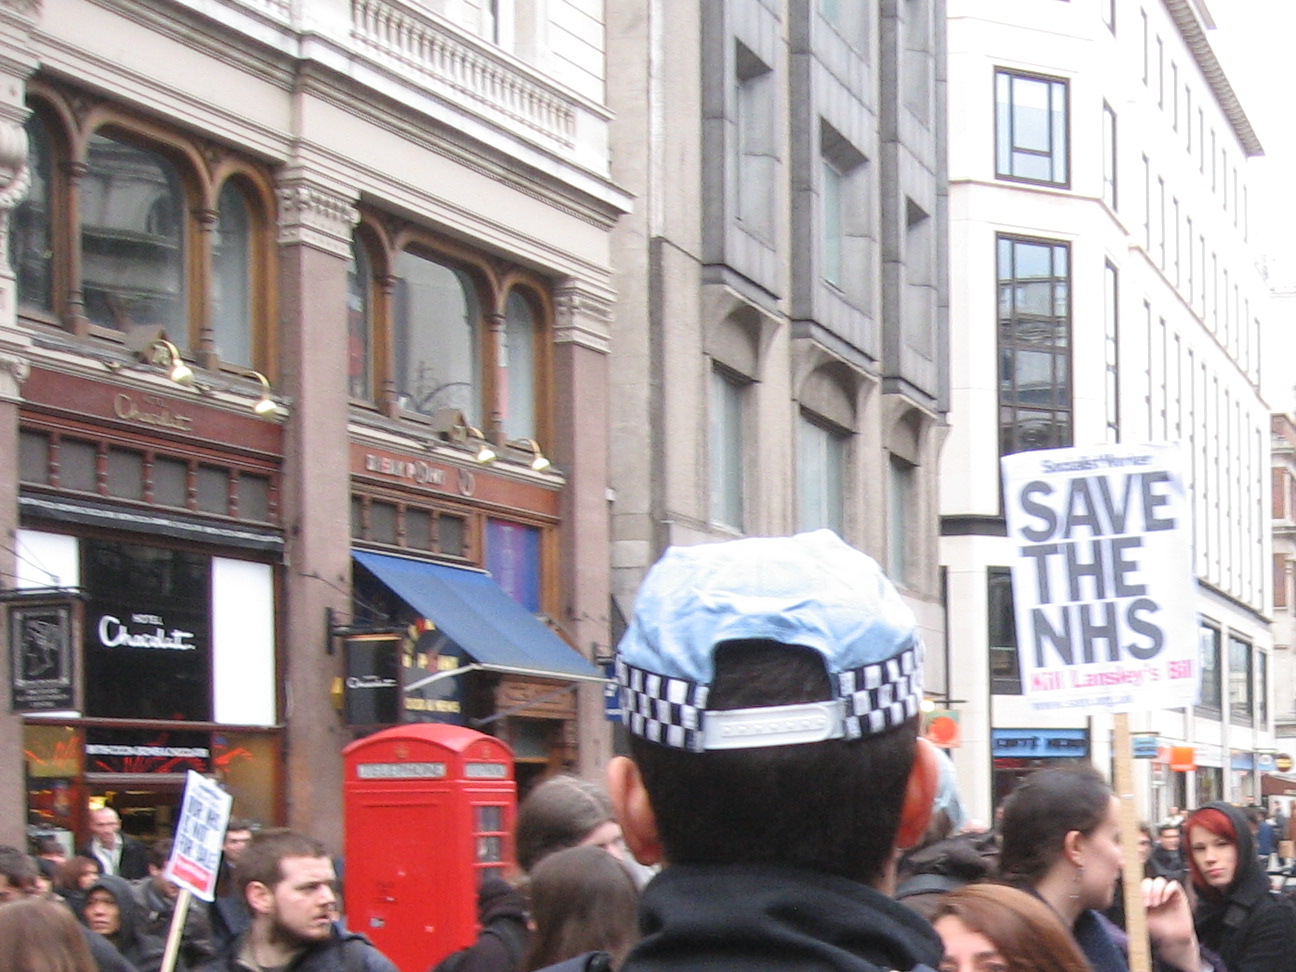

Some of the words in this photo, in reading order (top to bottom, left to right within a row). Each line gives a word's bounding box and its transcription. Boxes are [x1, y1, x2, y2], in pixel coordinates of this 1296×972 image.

[1020, 469, 1178, 543] SAVE
[1020, 535, 1149, 606] THE
[1031, 596, 1165, 669] NHS
